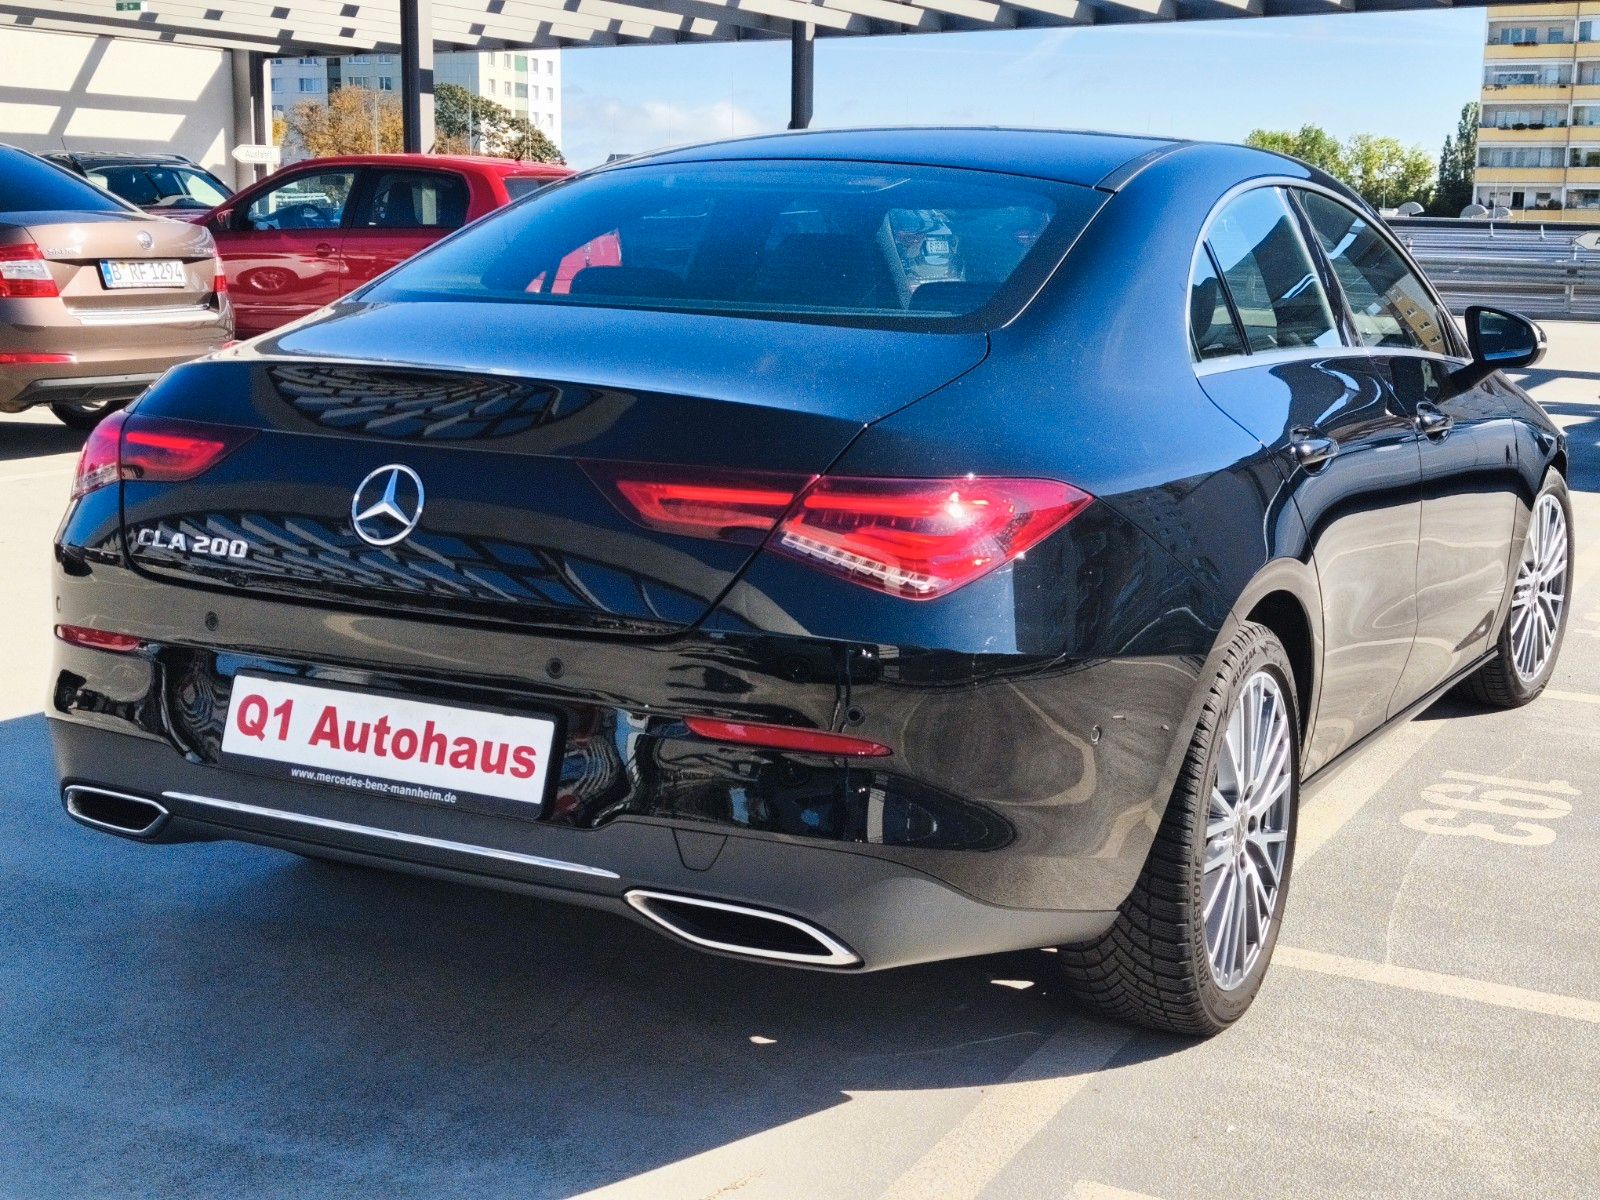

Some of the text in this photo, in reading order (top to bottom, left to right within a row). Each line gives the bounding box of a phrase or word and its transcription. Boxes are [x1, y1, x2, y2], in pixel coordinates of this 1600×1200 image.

[110, 262, 183, 281] B RF 1294
[137, 528, 249, 558] CLA 200
[236, 693, 537, 780] Q1 Autohaus
[290, 767, 457, 804] www.mercedes-benz-mannheim.de
[1400, 770, 1583, 846] 193
[1193, 855, 1209, 988] BRIDGESTONE
